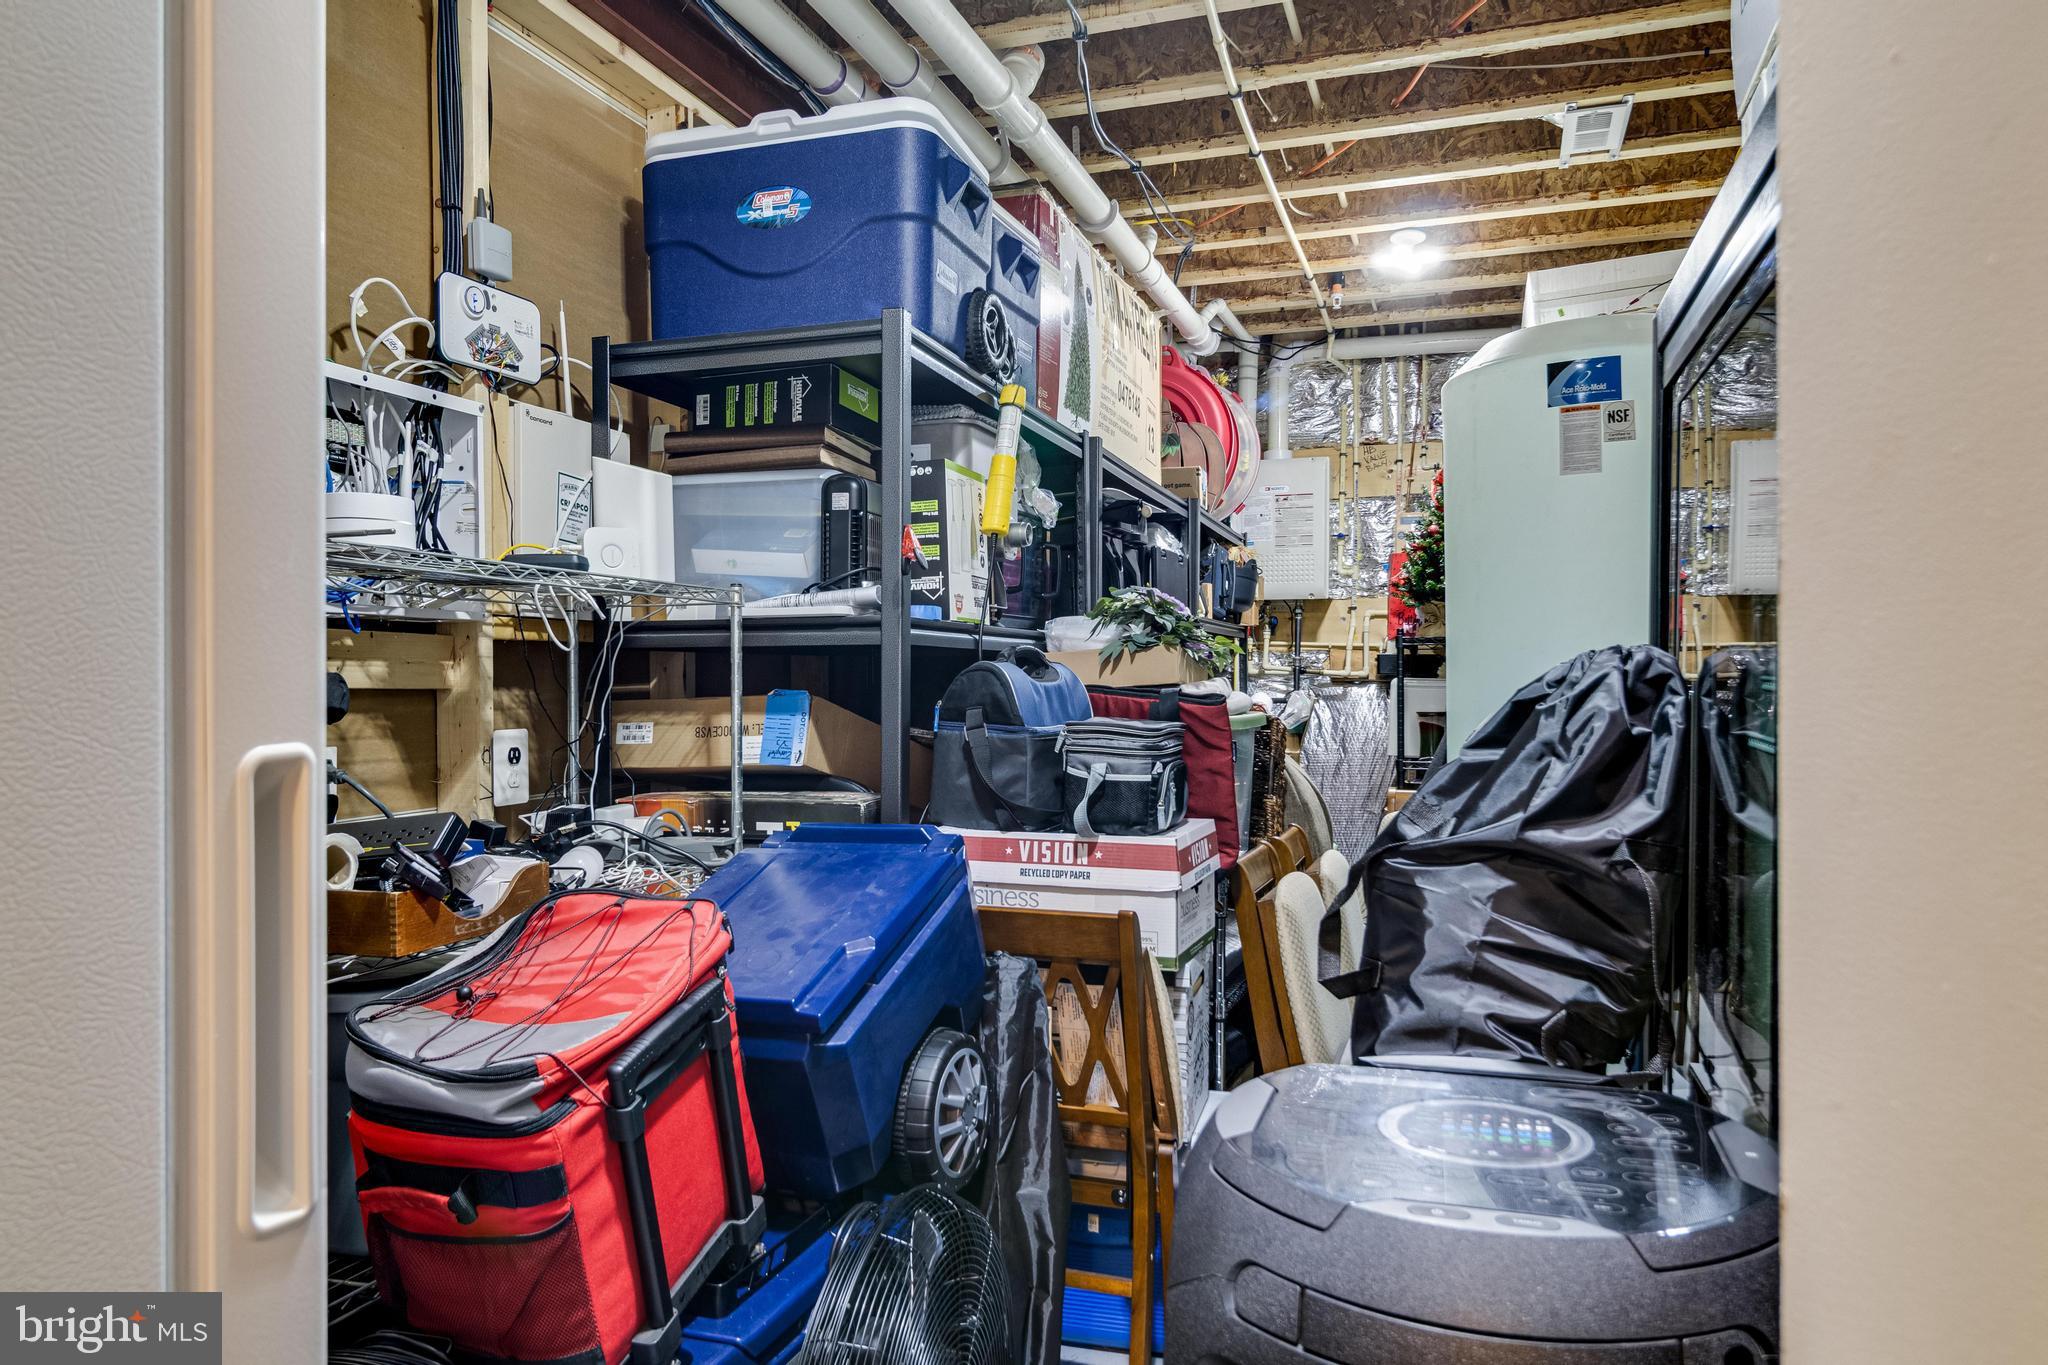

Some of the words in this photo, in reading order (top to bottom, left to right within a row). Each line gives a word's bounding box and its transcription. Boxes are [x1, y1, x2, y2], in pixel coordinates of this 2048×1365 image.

[1561, 386, 1573, 394] Ace
[530, 415, 553, 426] concord
[1607, 409, 1630, 424] NSF
[1148, 424, 1155, 454] 13
[911, 582, 940, 590] HOMV
[1019, 840, 1088, 865] VISION
[1020, 868, 1051, 878] RECYCLED
[1051, 869, 1069, 879] COPY
[1069, 871, 1091, 880] PAPER
[975, 888, 1039, 908] siness
